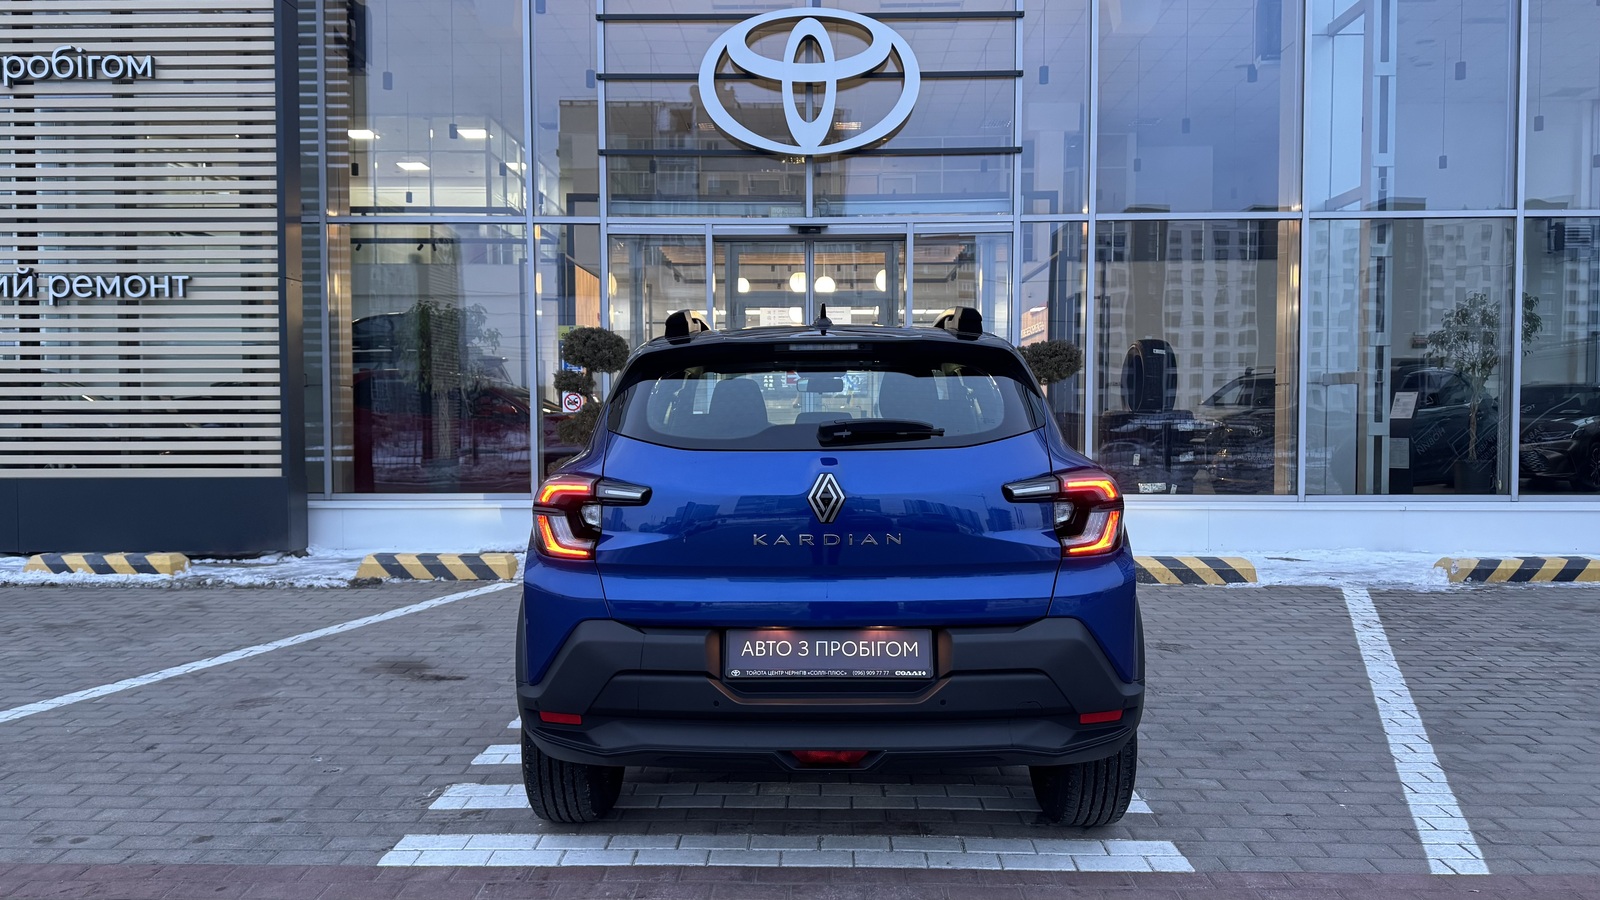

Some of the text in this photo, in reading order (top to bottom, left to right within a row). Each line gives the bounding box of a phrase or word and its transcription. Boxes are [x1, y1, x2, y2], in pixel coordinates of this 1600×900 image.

[0, 45, 154, 88] робігом
[48, 274, 191, 307] ремонт
[752, 533, 903, 546] KARDIAN
[741, 640, 919, 657] АВТО З ПРОБІГОМ
